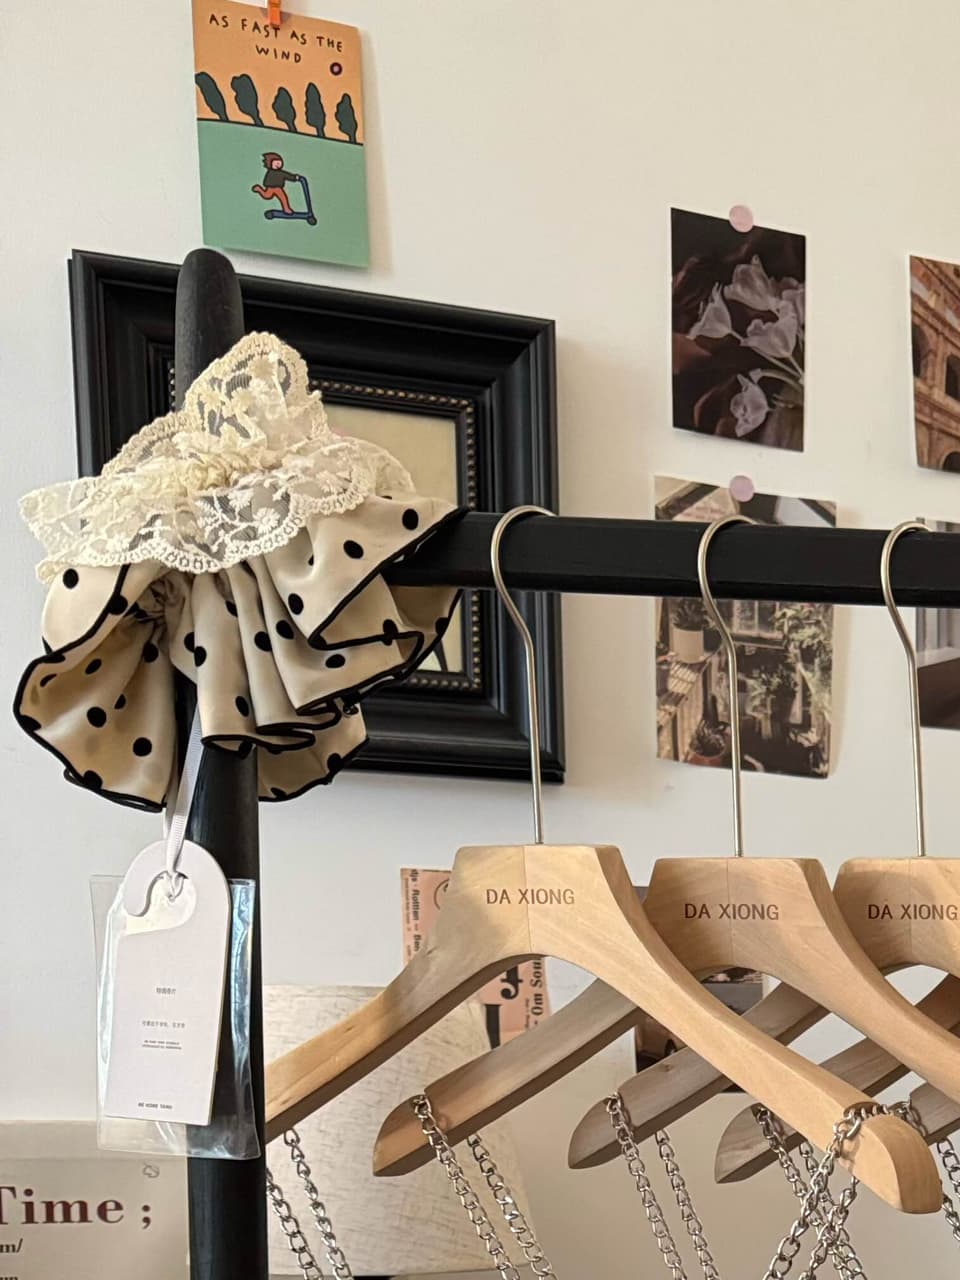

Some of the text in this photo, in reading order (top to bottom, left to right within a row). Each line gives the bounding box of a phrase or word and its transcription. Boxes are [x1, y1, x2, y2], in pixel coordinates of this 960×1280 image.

[209, 14, 343, 52] AS FAST AS THE
[256, 45, 302, 63] WIND
[486, 889, 575, 905] DA XIONG
[684, 903, 780, 921] DA XIONG
[867, 903, 959, 921] DA XIONG
[530, 957, 545, 988] Sou
